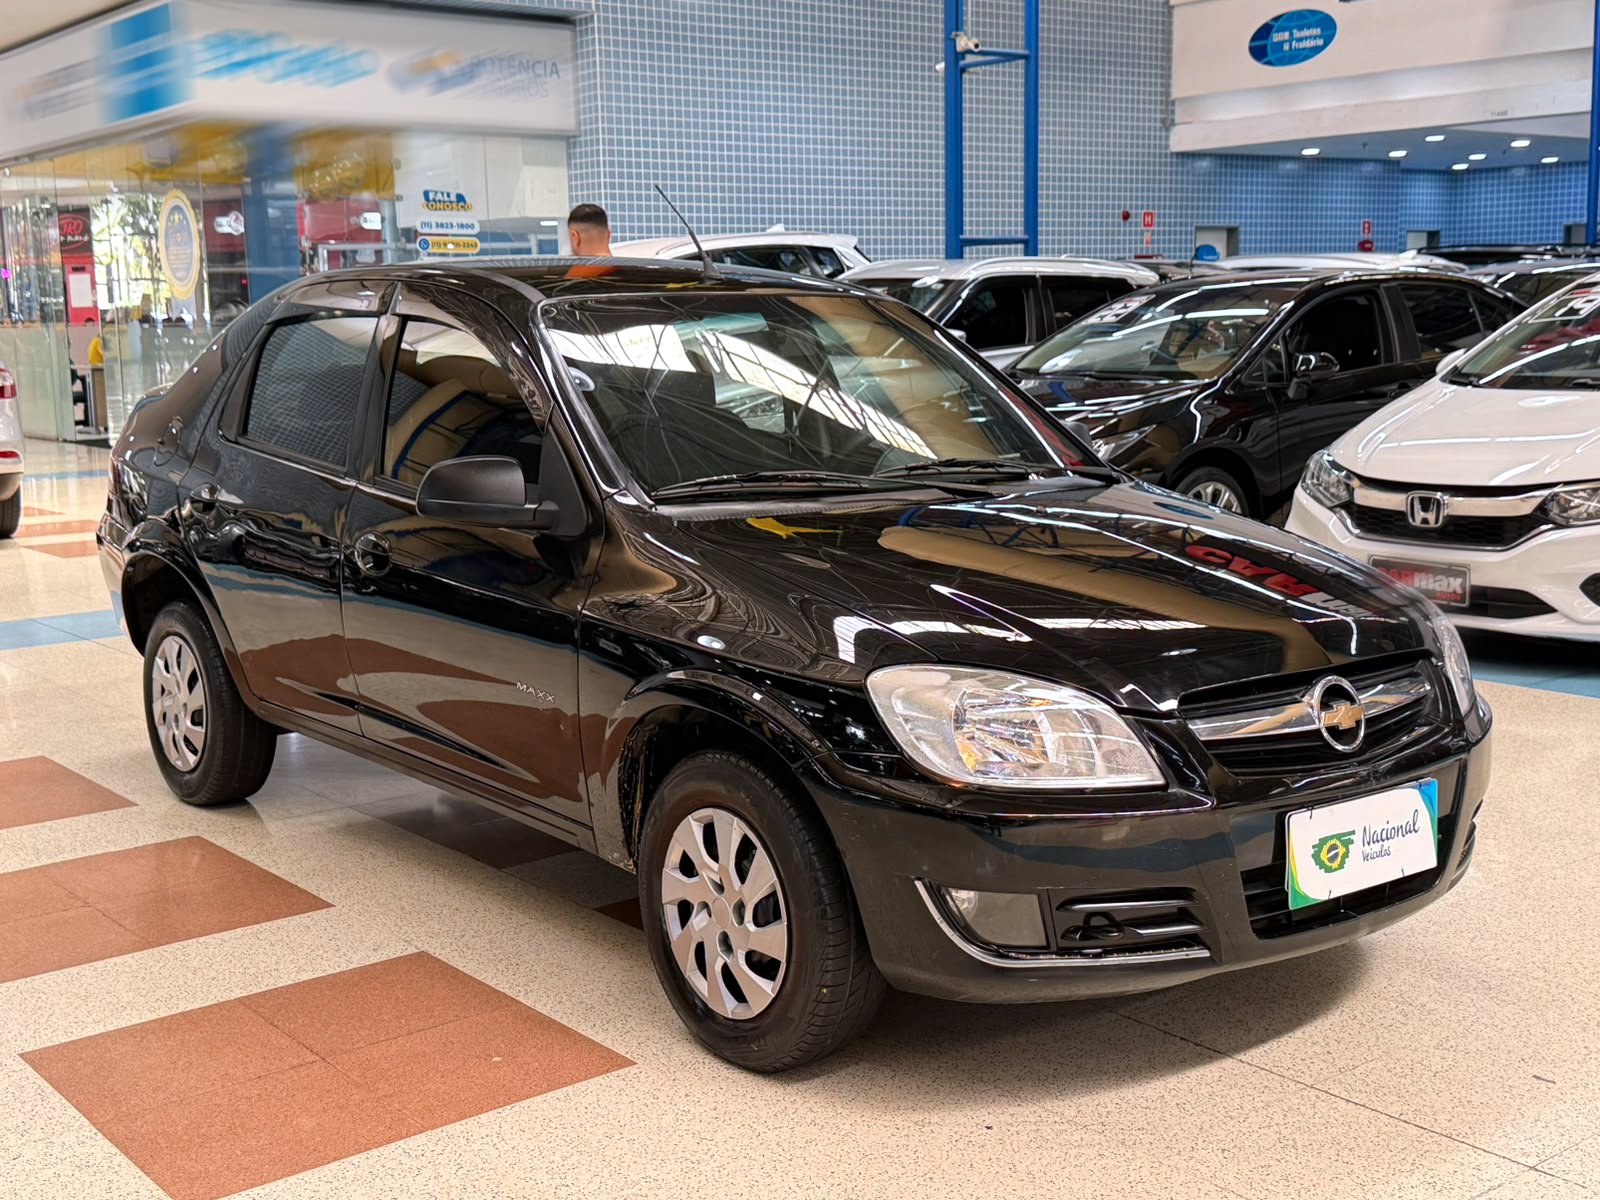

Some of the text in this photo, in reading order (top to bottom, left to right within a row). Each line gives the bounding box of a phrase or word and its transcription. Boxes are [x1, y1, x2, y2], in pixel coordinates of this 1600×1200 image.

[1292, 27, 1321, 39] Toaletes
[428, 191, 457, 202] FALE
[516, 681, 555, 703] MAXX
[1362, 808, 1421, 848] Nacional
[1361, 844, 1392, 863] Veículos
